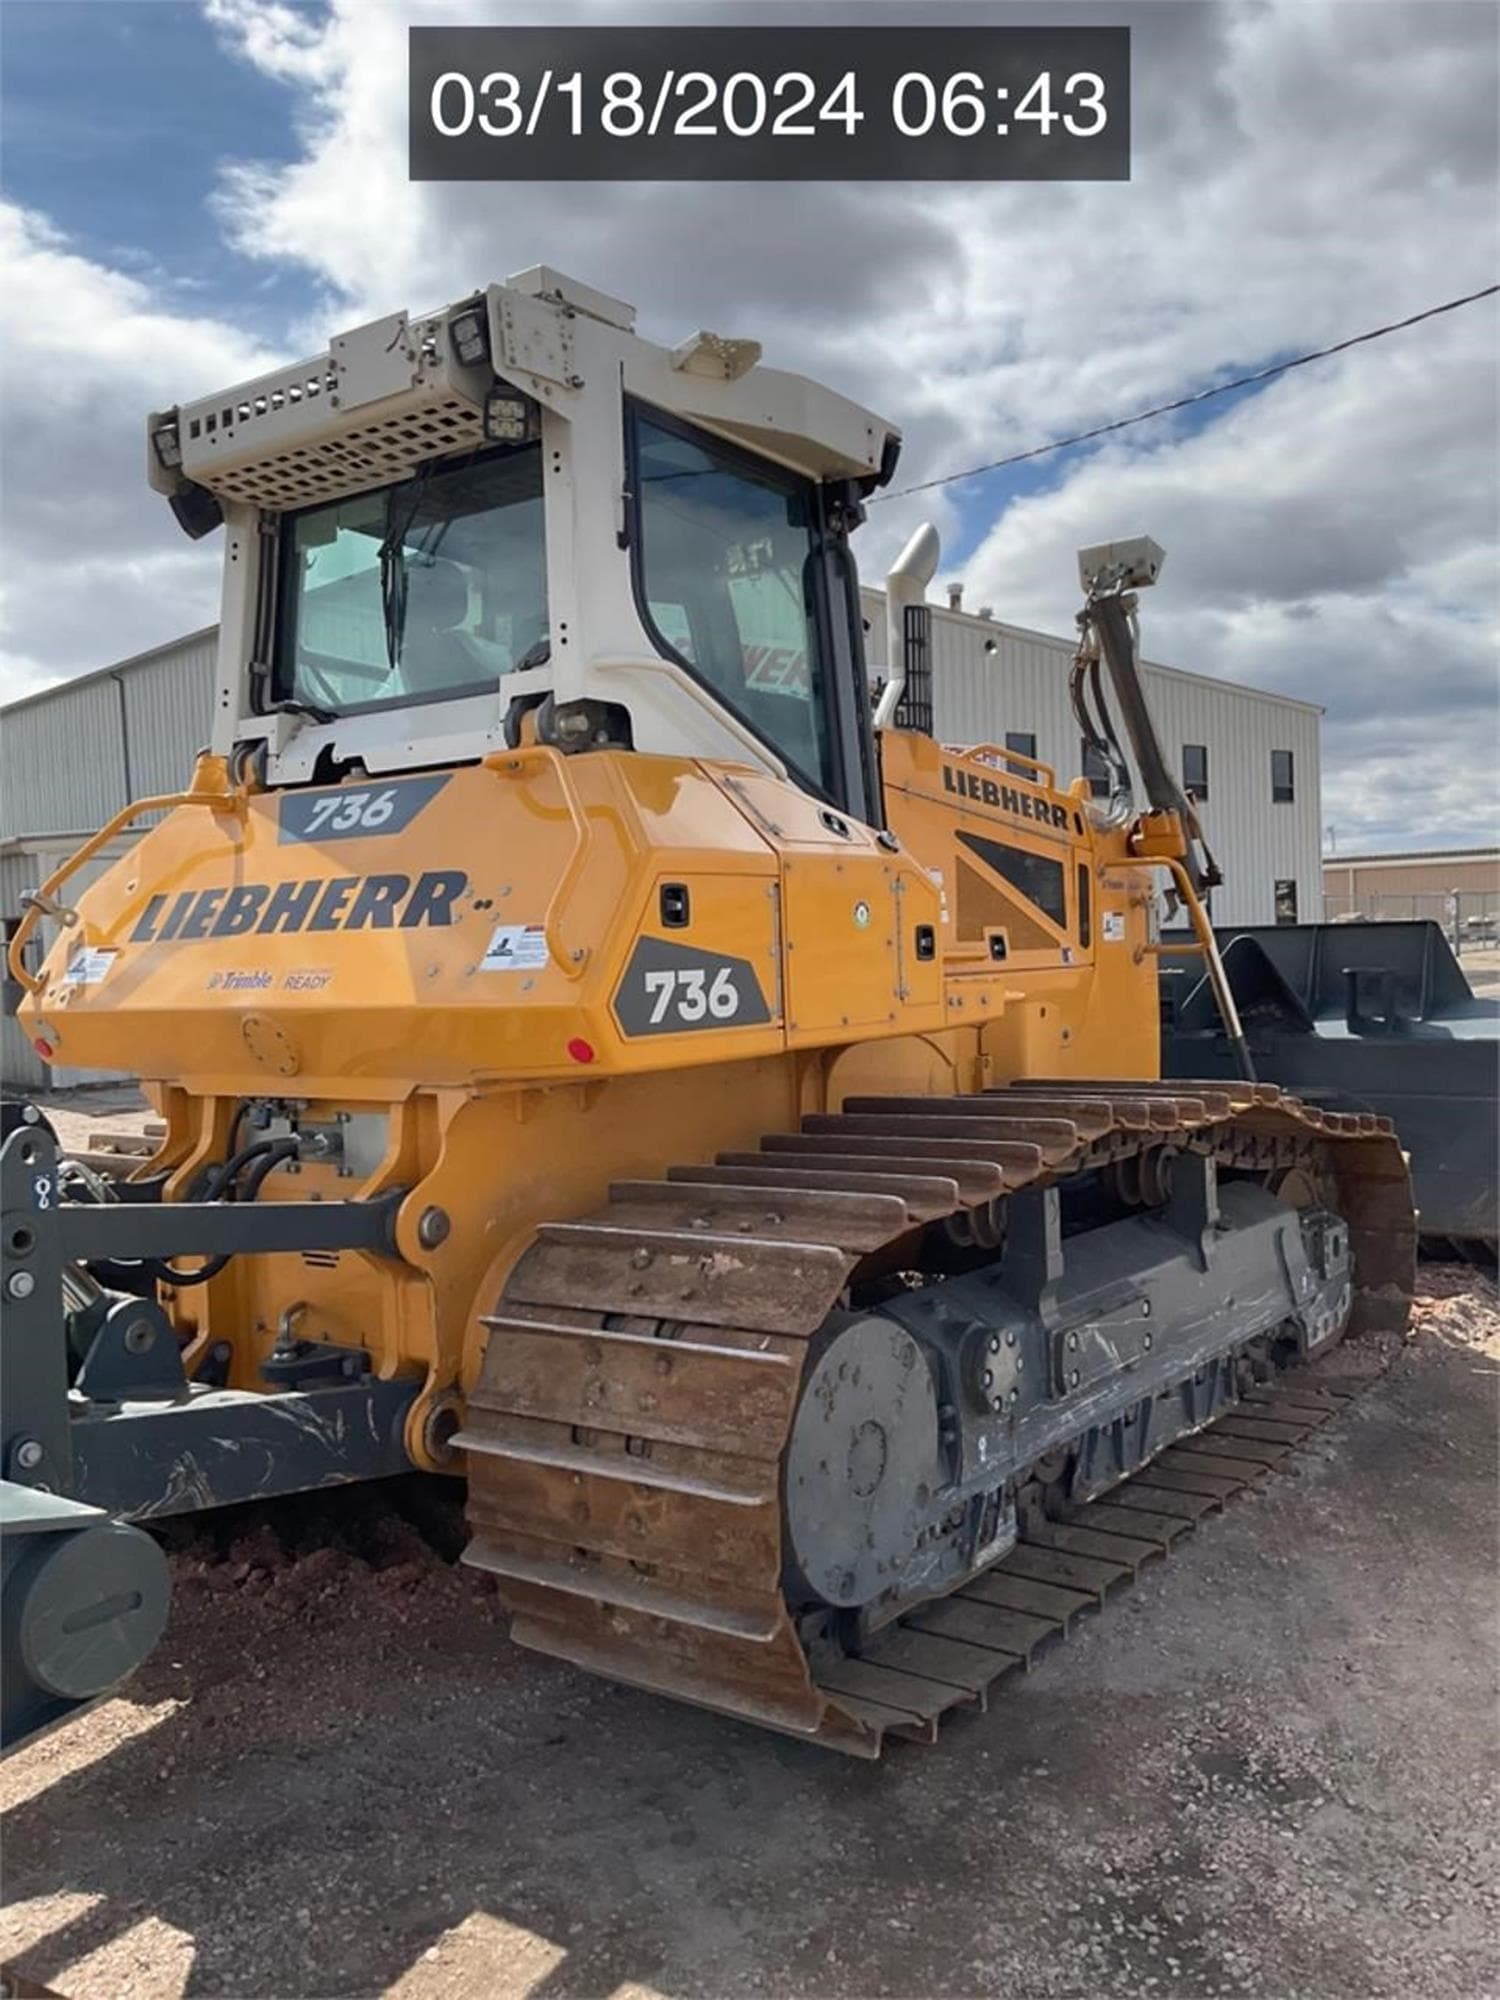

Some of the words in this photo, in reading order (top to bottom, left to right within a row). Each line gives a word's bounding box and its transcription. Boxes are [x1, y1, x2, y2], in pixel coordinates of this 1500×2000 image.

[304, 789, 398, 834] 736
[942, 764, 1069, 831] LIEBHERR
[128, 871, 468, 943] LIEBHERR
[221, 971, 272, 989] Trimble
[284, 975, 332, 990] READY
[644, 967, 739, 1024] 736
